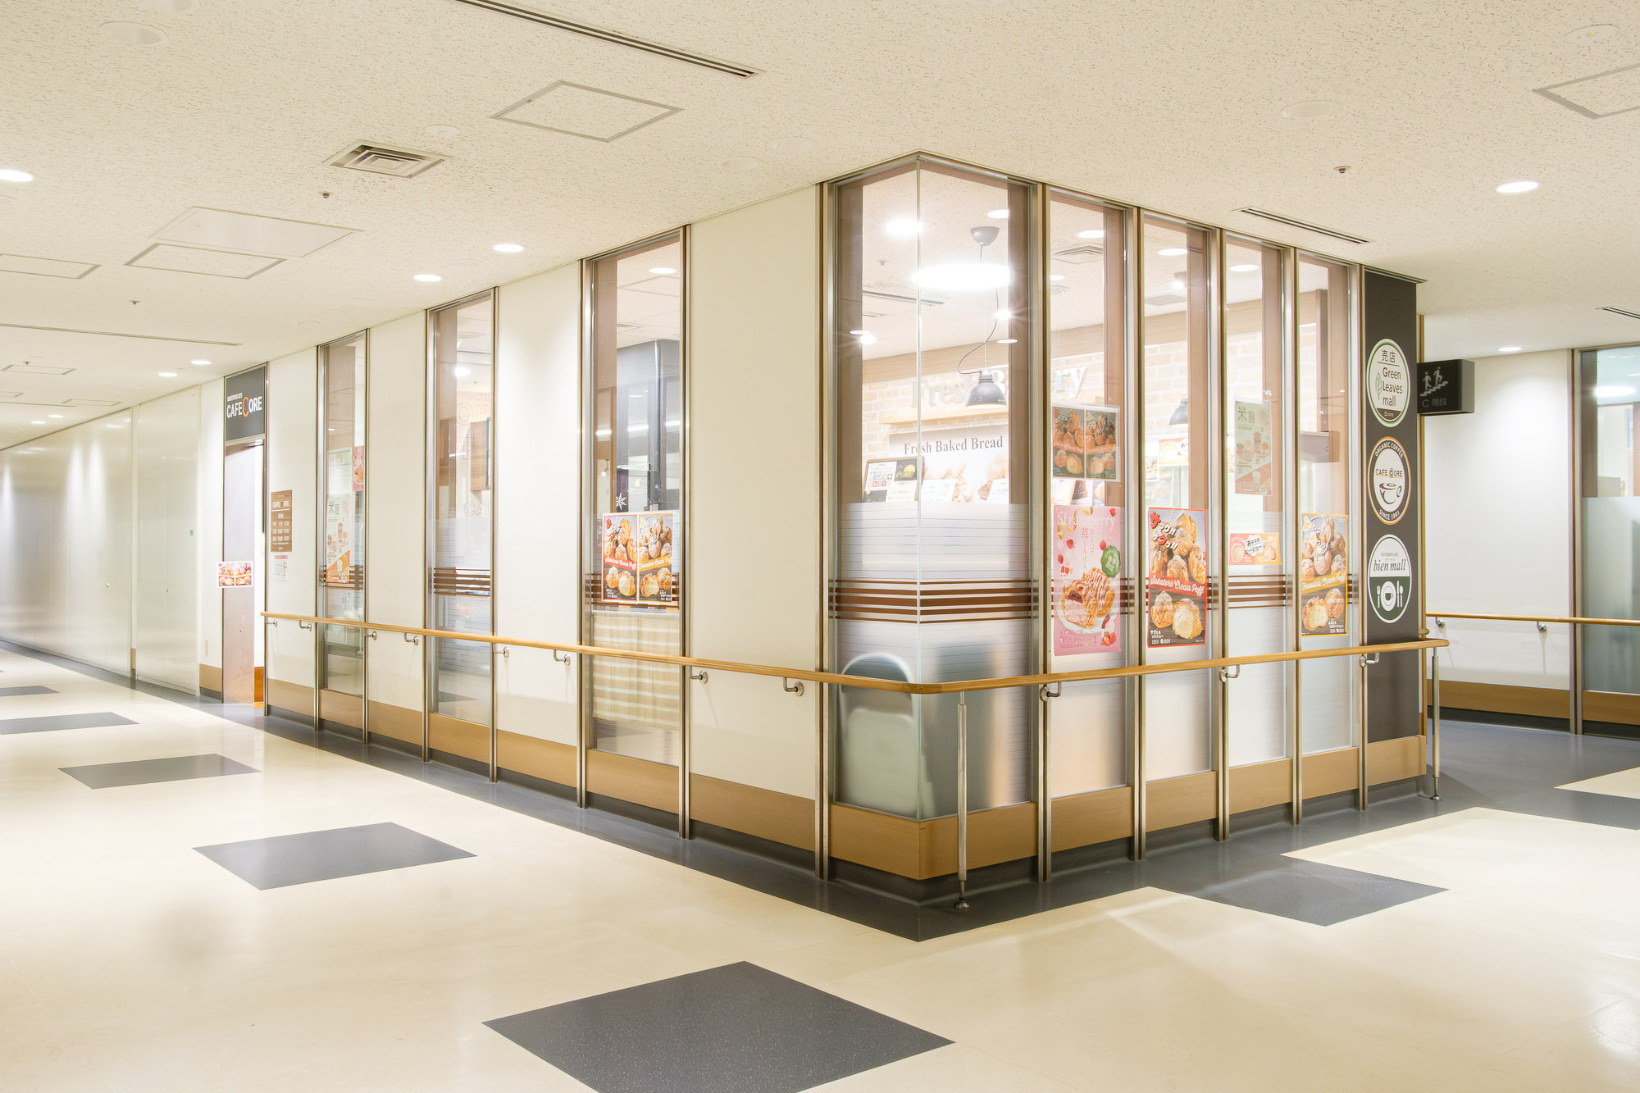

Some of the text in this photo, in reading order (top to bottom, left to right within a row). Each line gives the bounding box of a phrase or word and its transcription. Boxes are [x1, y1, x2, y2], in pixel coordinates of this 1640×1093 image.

[1381, 349, 1396, 363] 売店
[1382, 367, 1402, 380] Green
[1382, 380, 1403, 394] Leaves
[1382, 395, 1397, 406] mall
[1421, 398, 1430, 408] C
[226, 401, 243, 419] CAFE
[935, 438, 968, 453] Baked
[971, 435, 1004, 450] Bread
[1375, 468, 1388, 476] CAFE
[1373, 558, 1407, 572] bien mall
